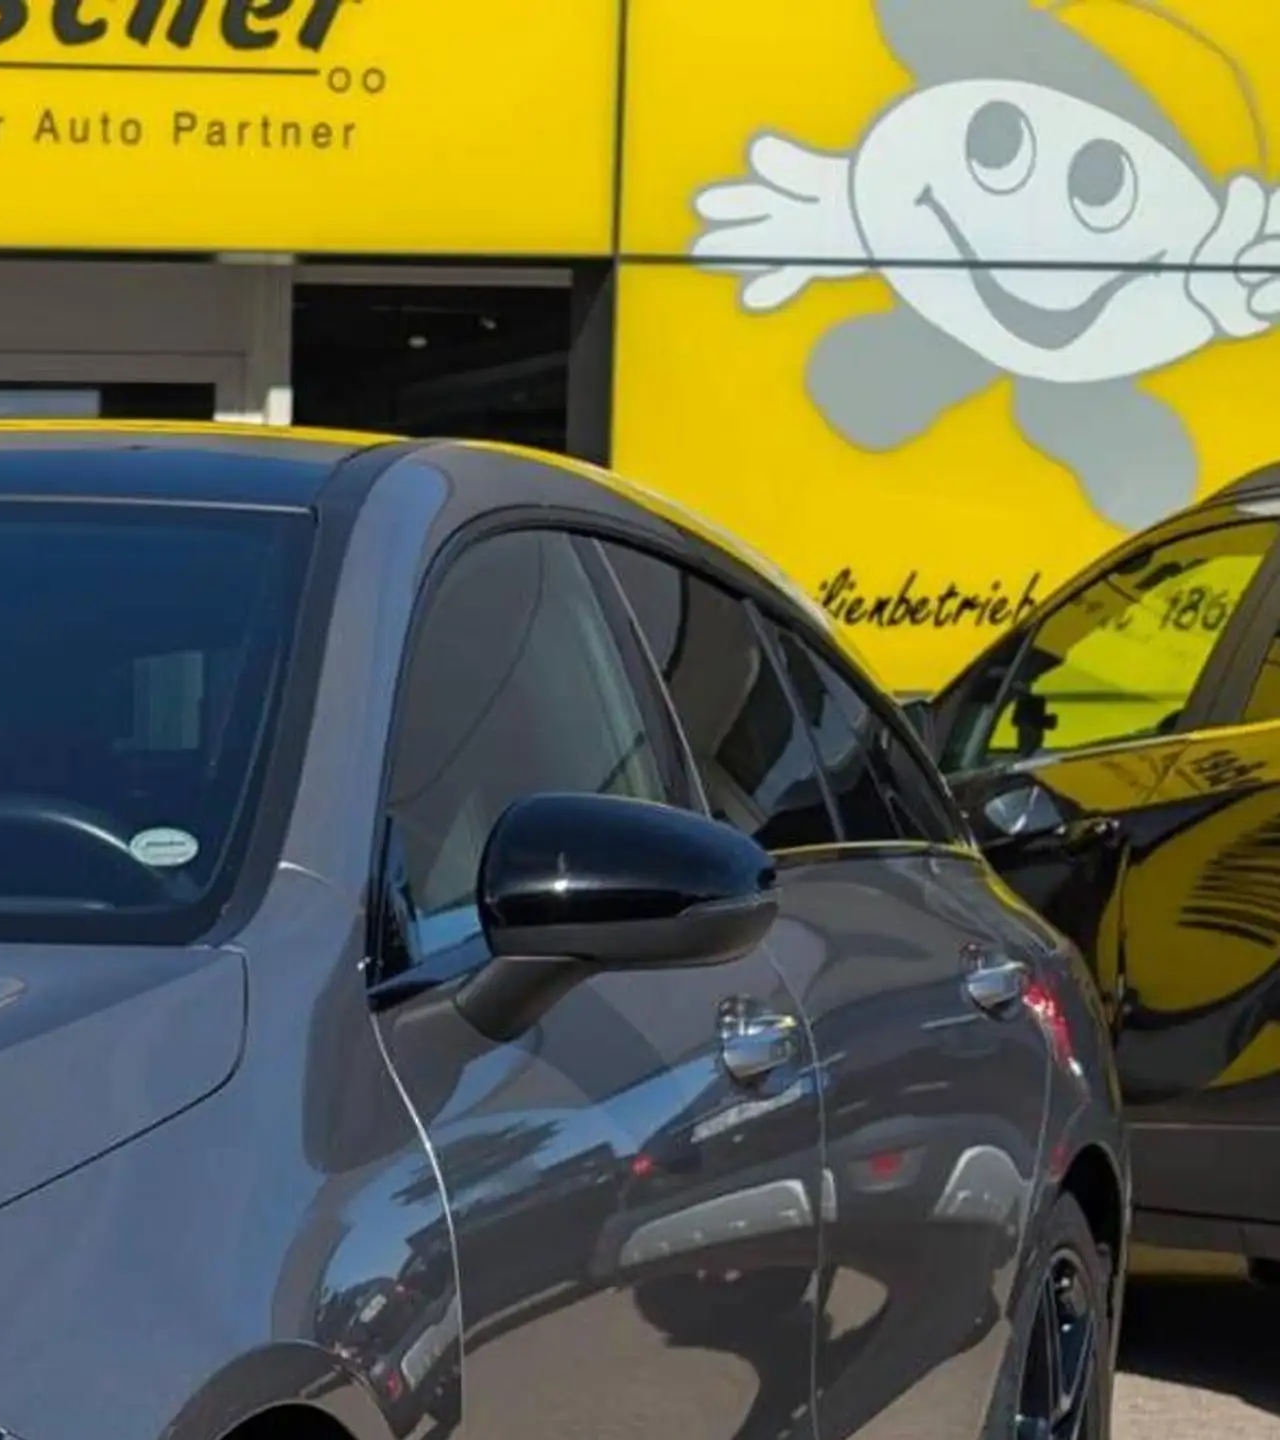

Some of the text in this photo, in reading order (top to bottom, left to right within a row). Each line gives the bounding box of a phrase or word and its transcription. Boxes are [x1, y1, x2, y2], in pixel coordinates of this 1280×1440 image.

[32, 109, 142, 146] Auto
[172, 111, 357, 150] Partner
[818, 567, 1041, 628] lienbetrieb
